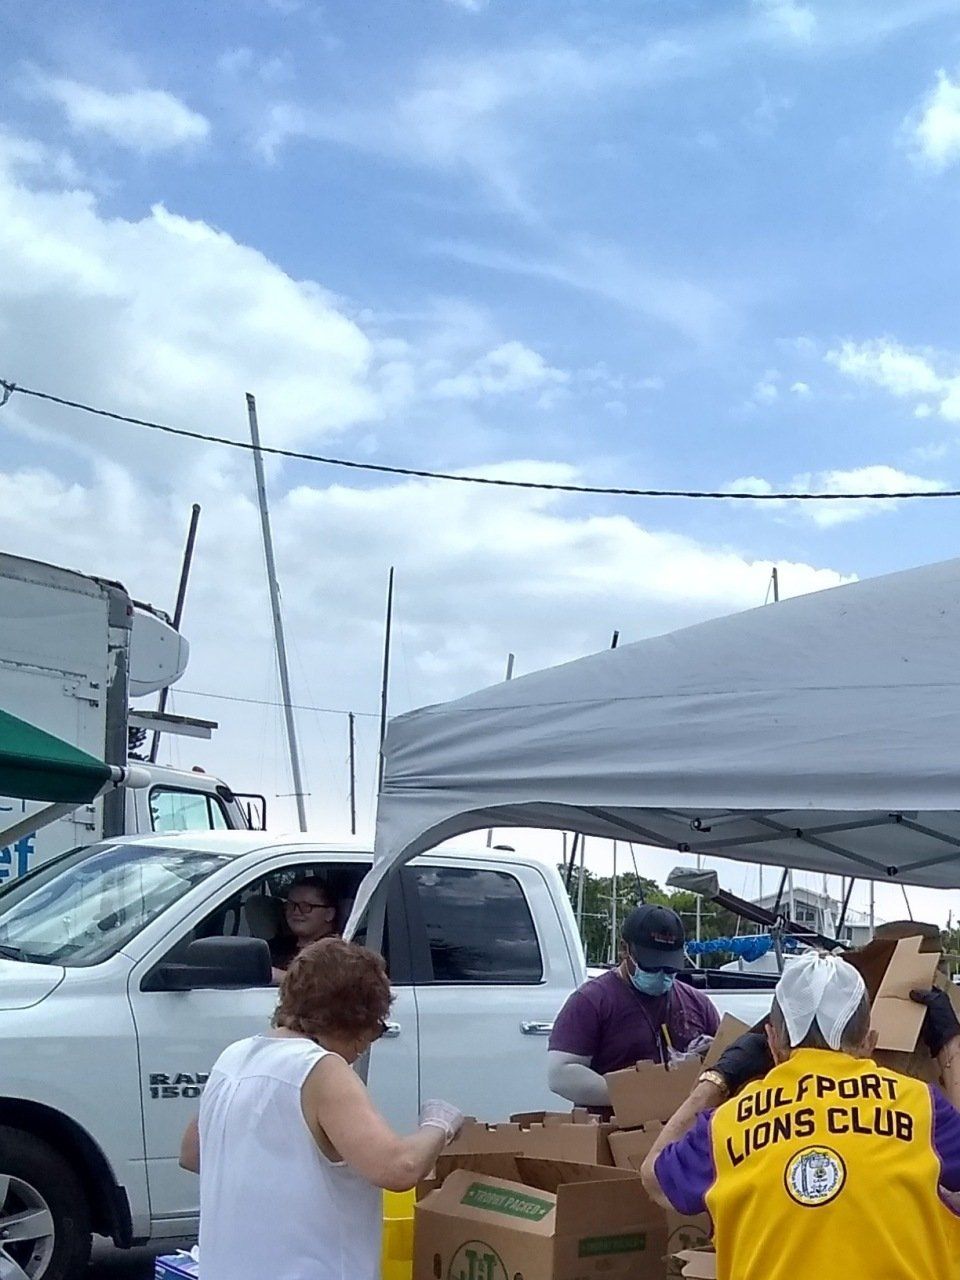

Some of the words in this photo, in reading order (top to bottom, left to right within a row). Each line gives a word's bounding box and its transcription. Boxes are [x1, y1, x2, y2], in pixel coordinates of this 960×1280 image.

[149, 1086, 205, 1099] 150
[737, 1074, 898, 1123] GULFPORT
[726, 1107, 815, 1167] LIONS
[827, 1107, 913, 1142] CLUB
[504, 1197, 541, 1215] PACKED
